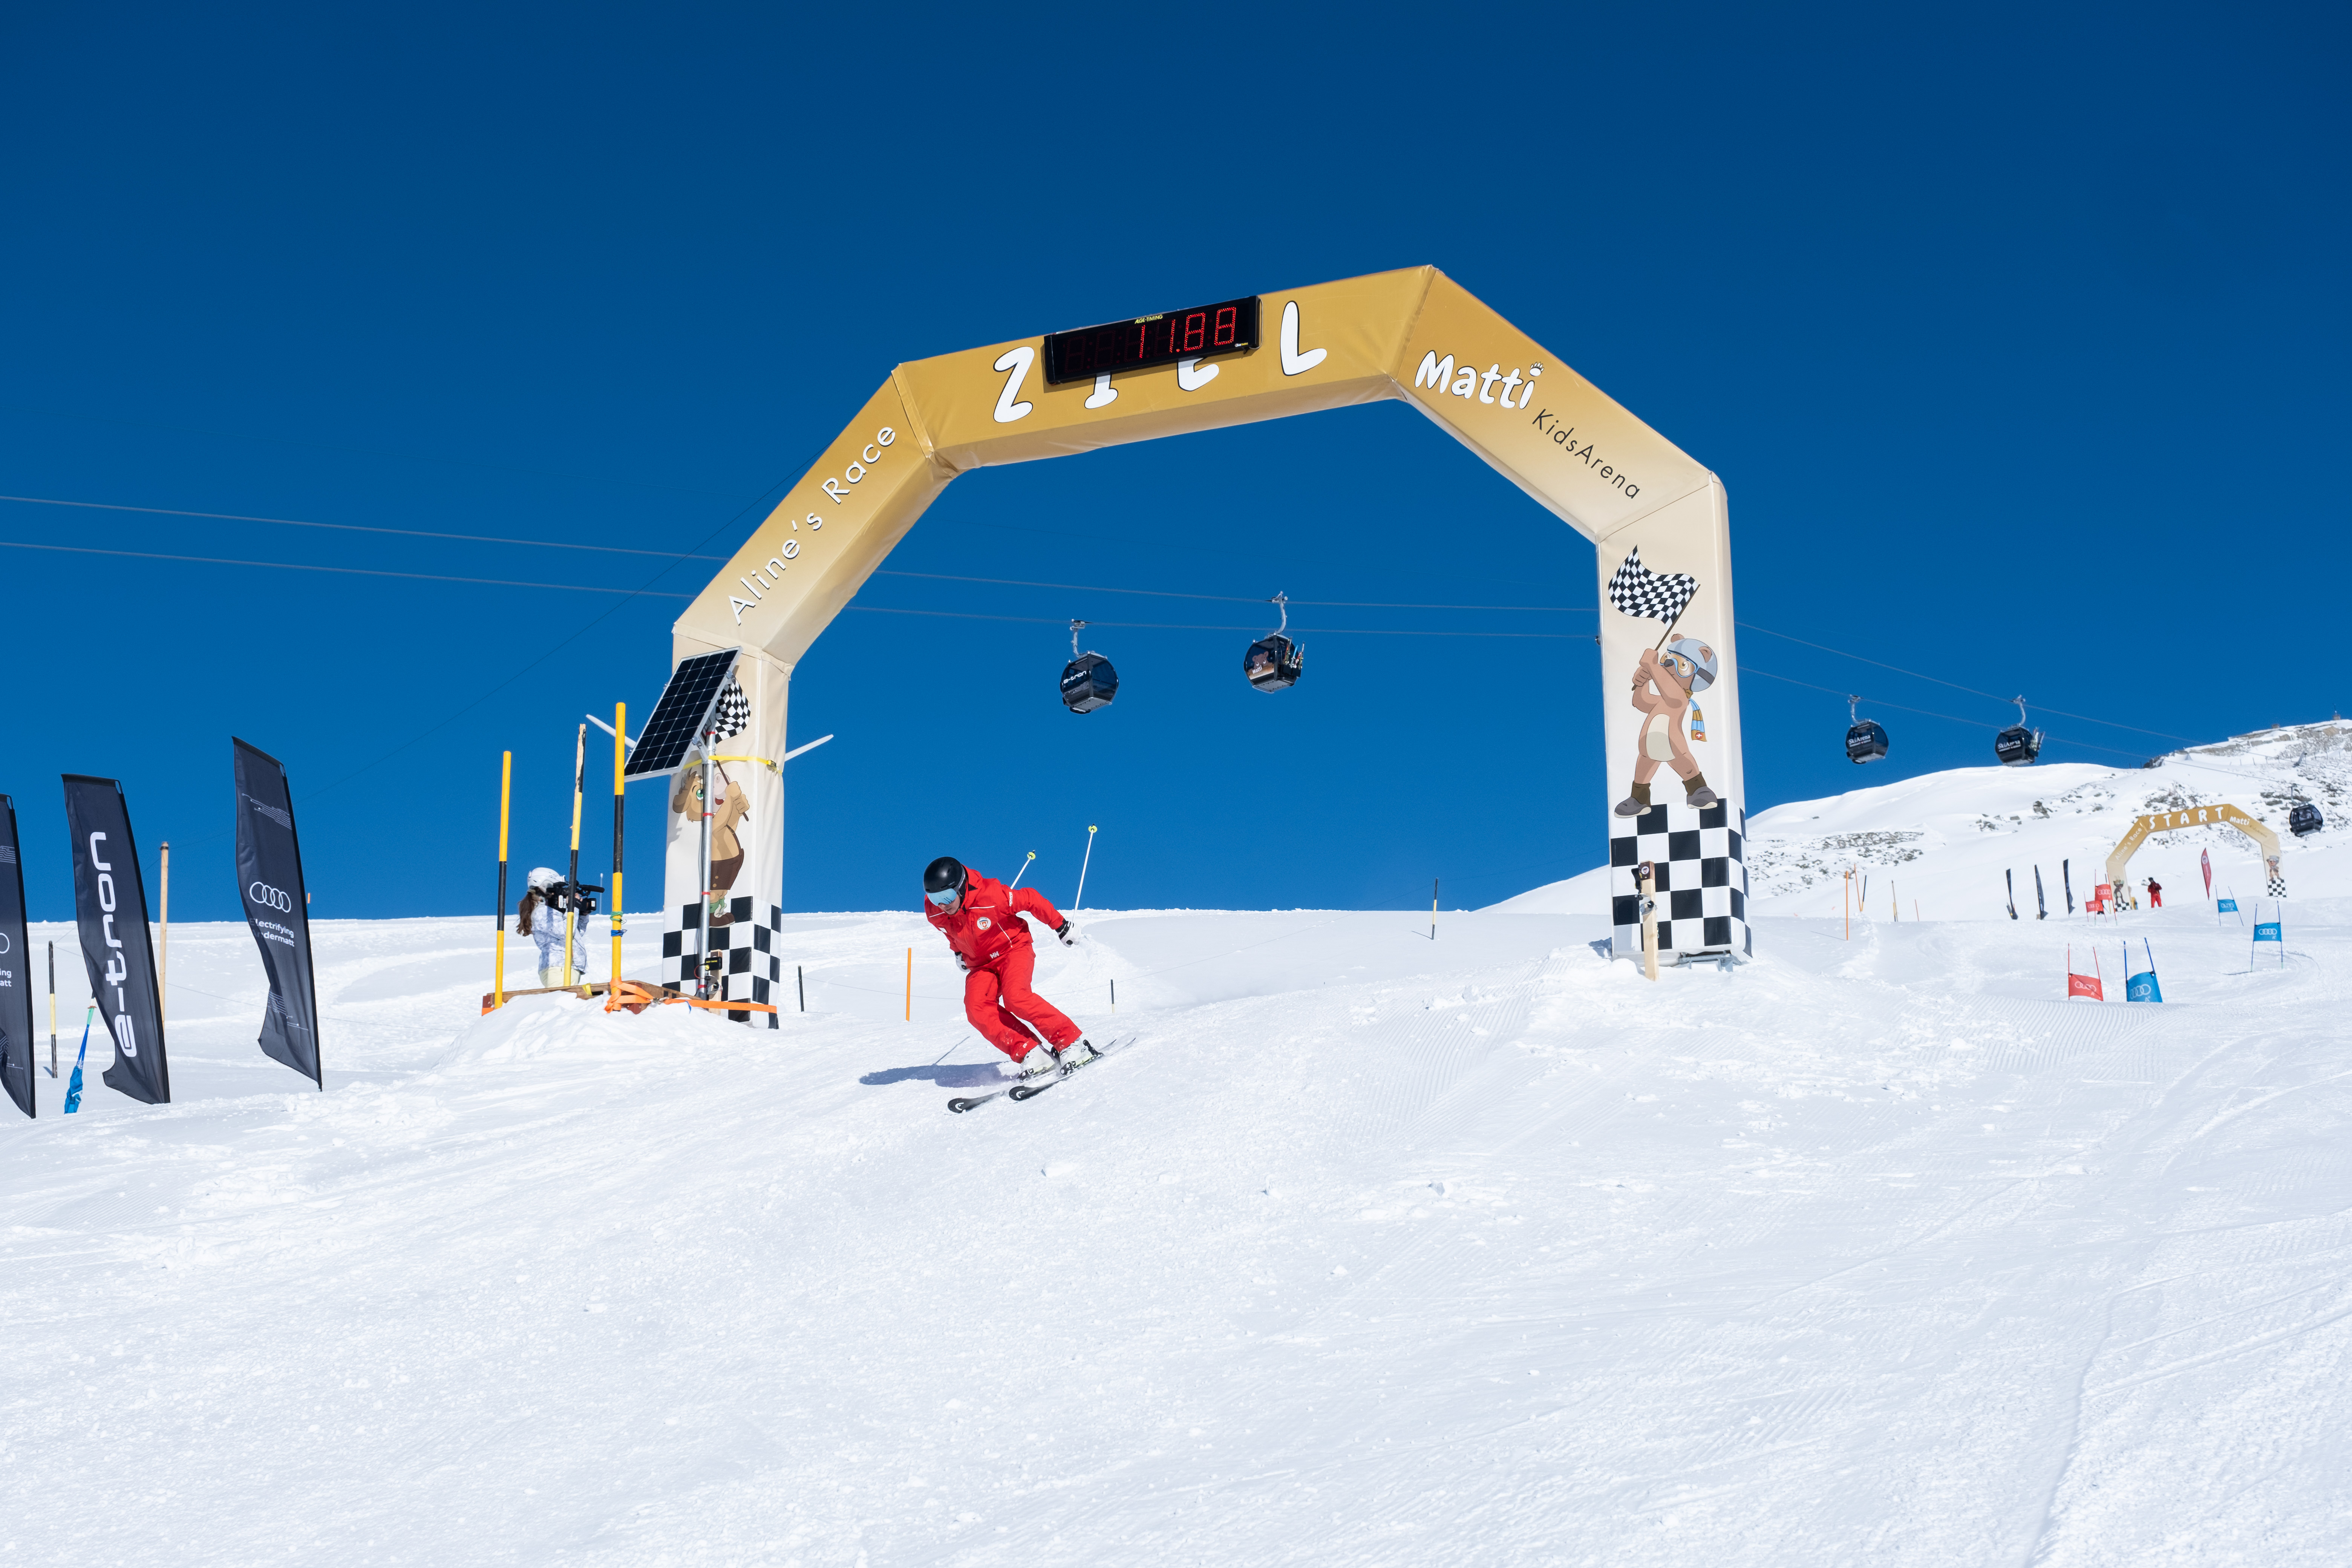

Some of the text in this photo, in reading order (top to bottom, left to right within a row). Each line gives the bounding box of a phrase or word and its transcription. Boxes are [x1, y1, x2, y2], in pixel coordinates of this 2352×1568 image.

[1414, 349, 1545, 410] Matti
[1532, 408, 1641, 499] KidsArena
[727, 426, 896, 626] Aline's Race
[1063, 670, 1087, 684] e-tron
[1252, 665, 1263, 674] Matti
[2148, 806, 2224, 830] START
[2229, 816, 2251, 825] Matti
[2128, 827, 2142, 841] Race
[249, 917, 294, 939] Electrifying
[90, 831, 137, 1058] e-tron
